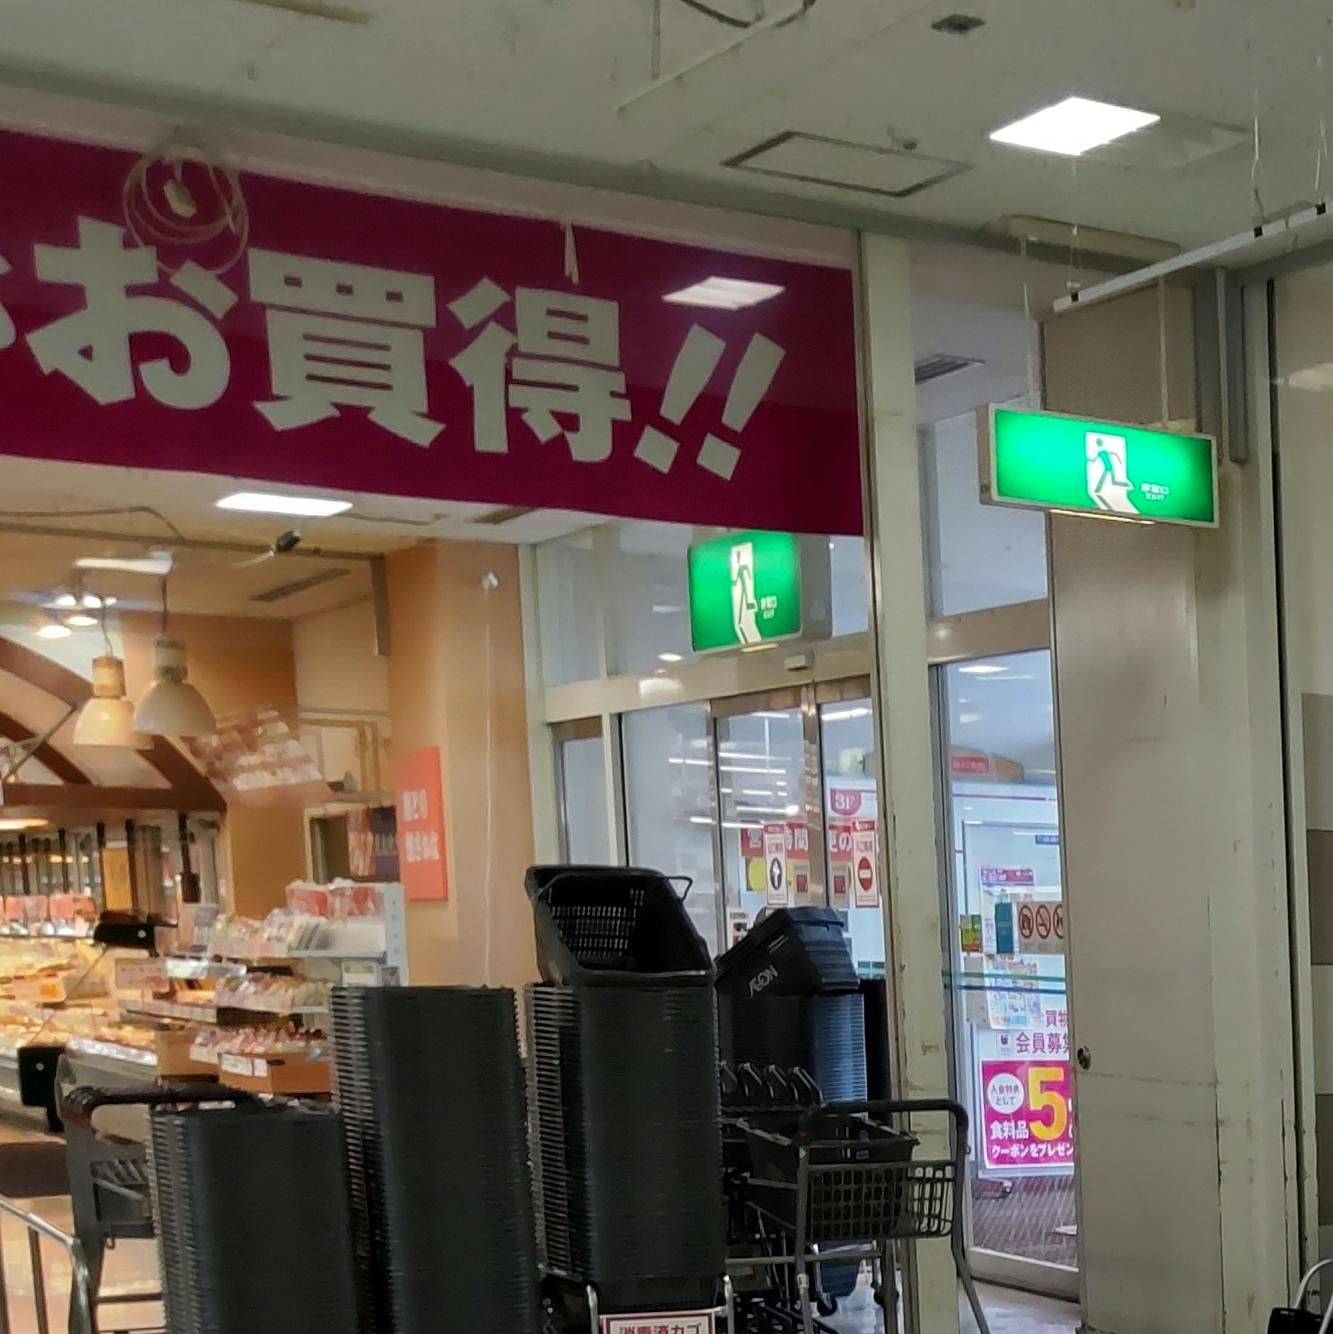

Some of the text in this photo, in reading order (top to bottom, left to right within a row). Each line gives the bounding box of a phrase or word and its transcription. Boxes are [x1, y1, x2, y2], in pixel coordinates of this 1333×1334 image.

[0, 214, 787, 481] お買得!!
[990, 1120, 1029, 1141] 食料品
[1028, 1066, 1067, 1141] 5
